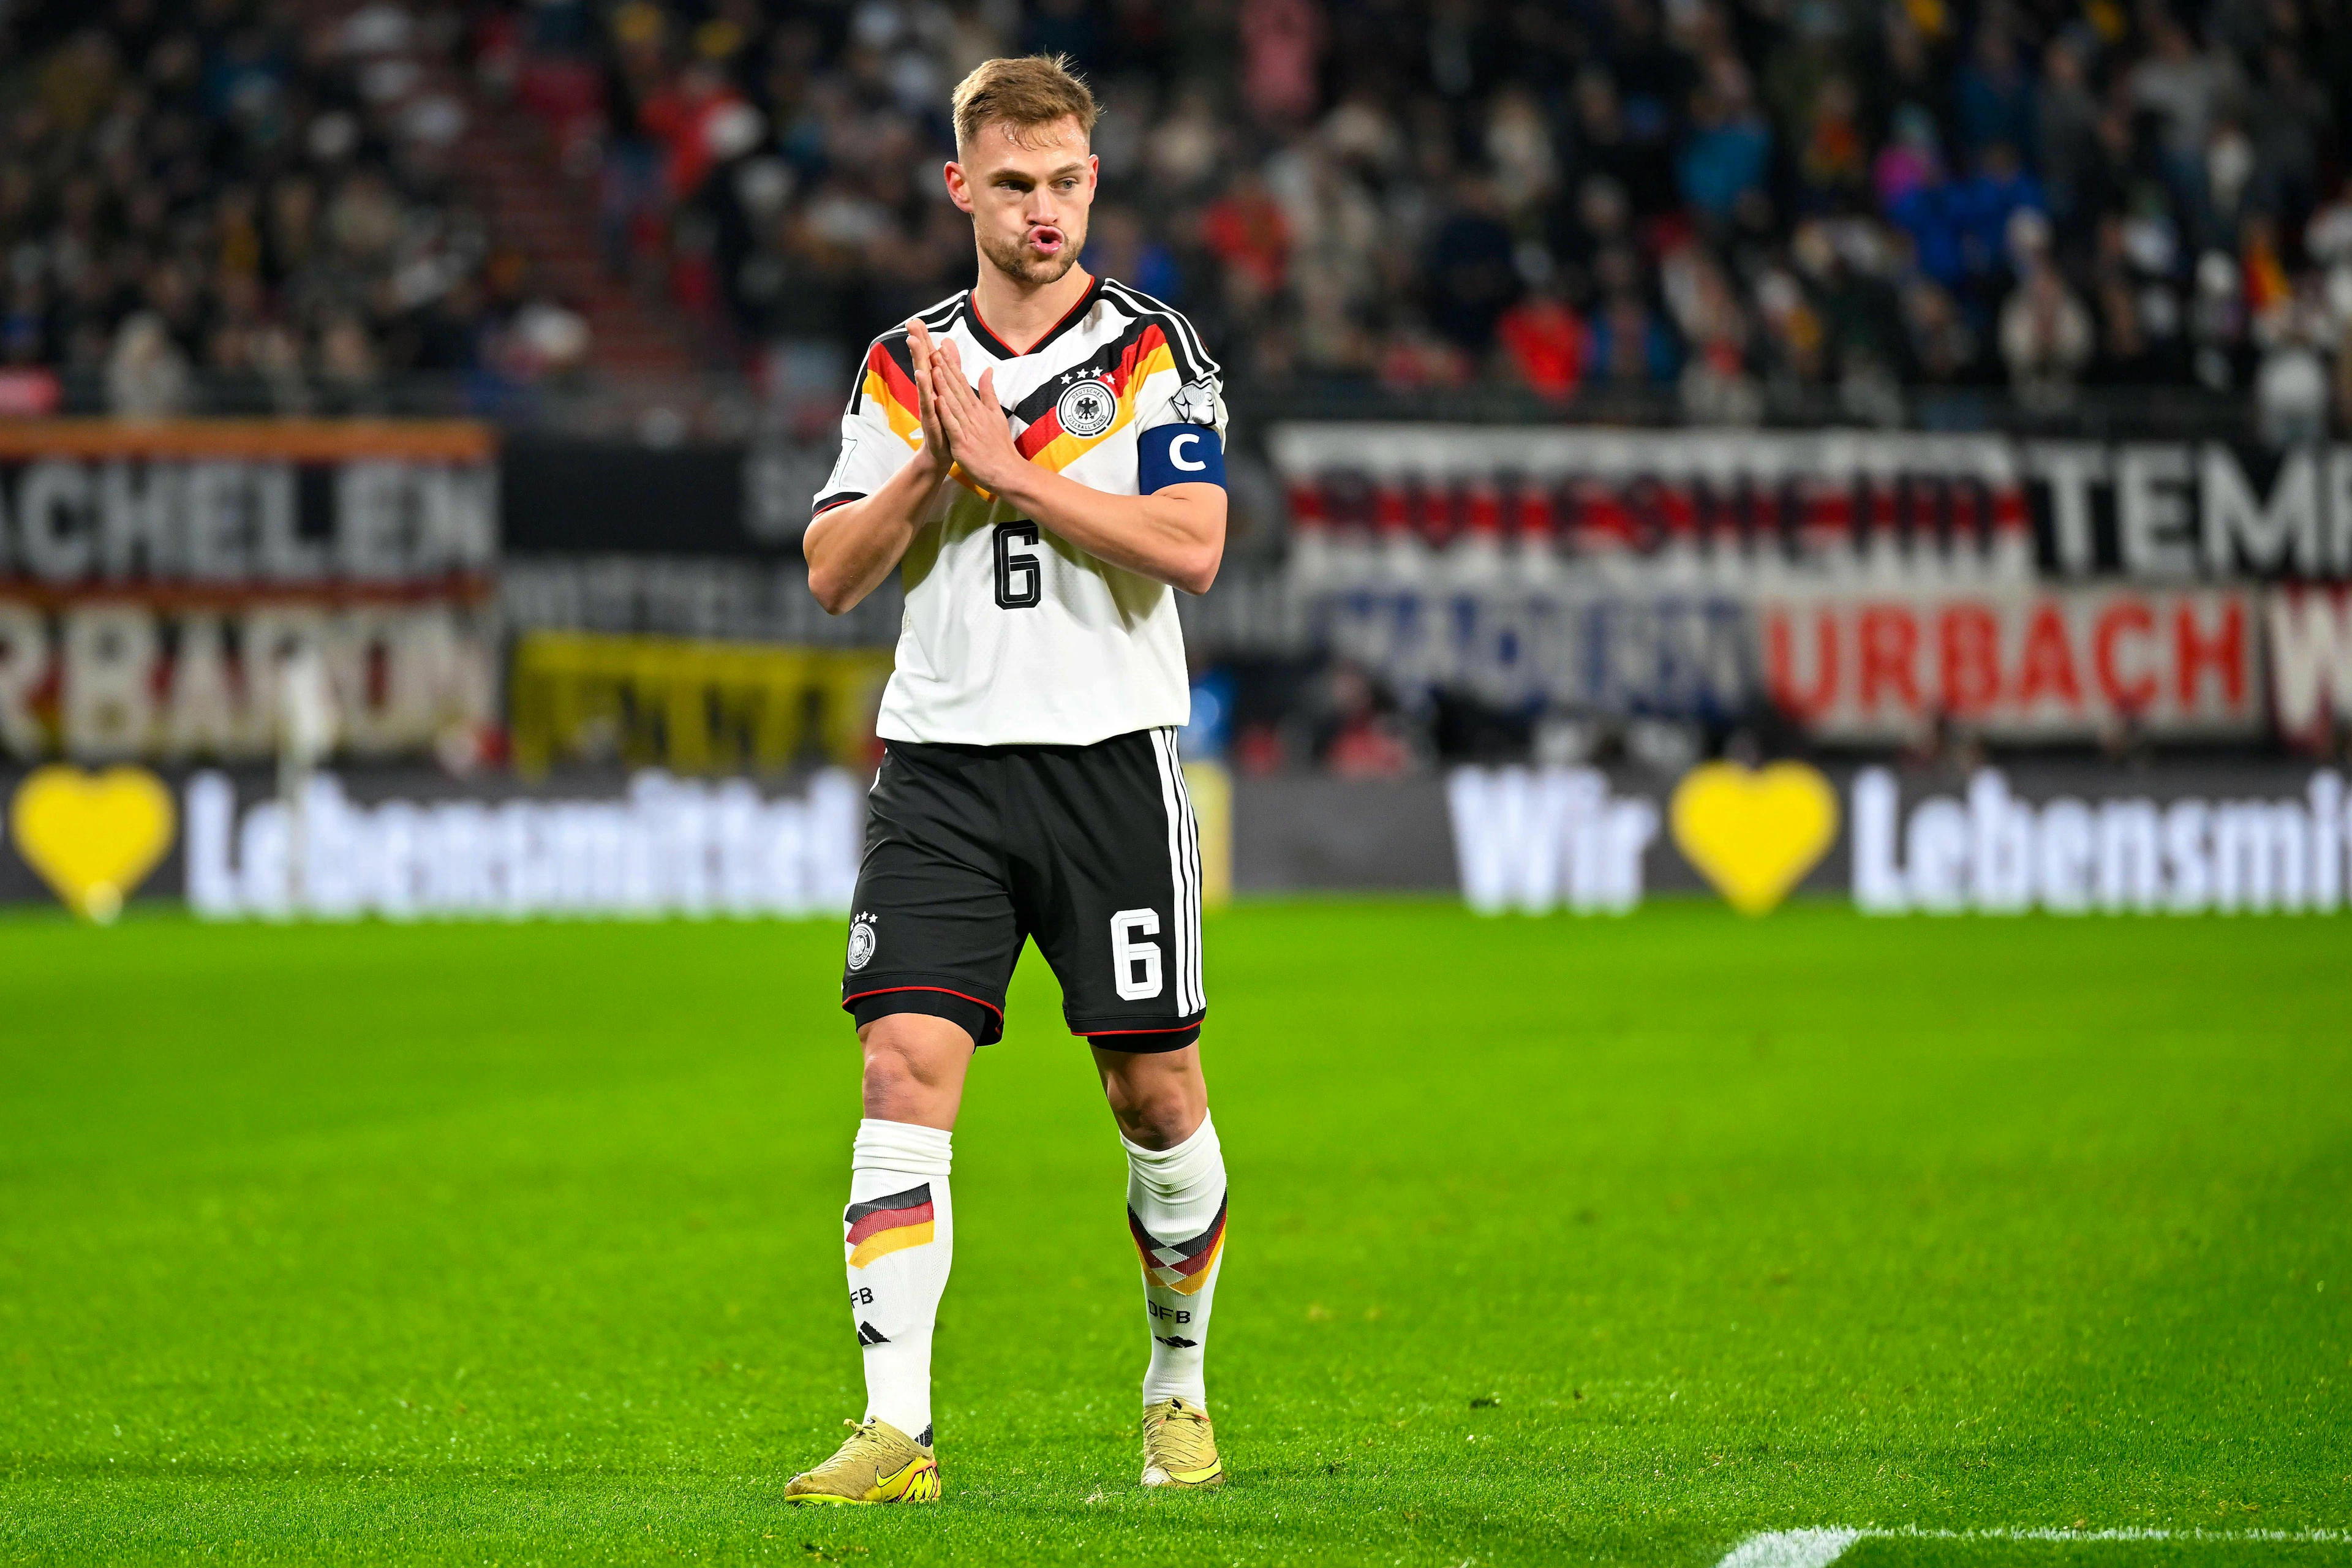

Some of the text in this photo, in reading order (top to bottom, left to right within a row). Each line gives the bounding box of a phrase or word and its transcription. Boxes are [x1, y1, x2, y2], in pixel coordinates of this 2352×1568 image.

[1068, 415, 1106, 429] FUSSBALL-BUND
[1072, 388, 1103, 399] DEUTSCHER
[1169, 434, 1206, 472] C
[0, 458, 497, 578] CHELEN
[992, 519, 1041, 610] 6
[1765, 590, 2247, 723] URBACH
[1446, 764, 2352, 917] Wir Lebensmi
[1110, 907, 1163, 1001] 6
[850, 1287, 874, 1309] FB
[1148, 1298, 1191, 1324] DFB
